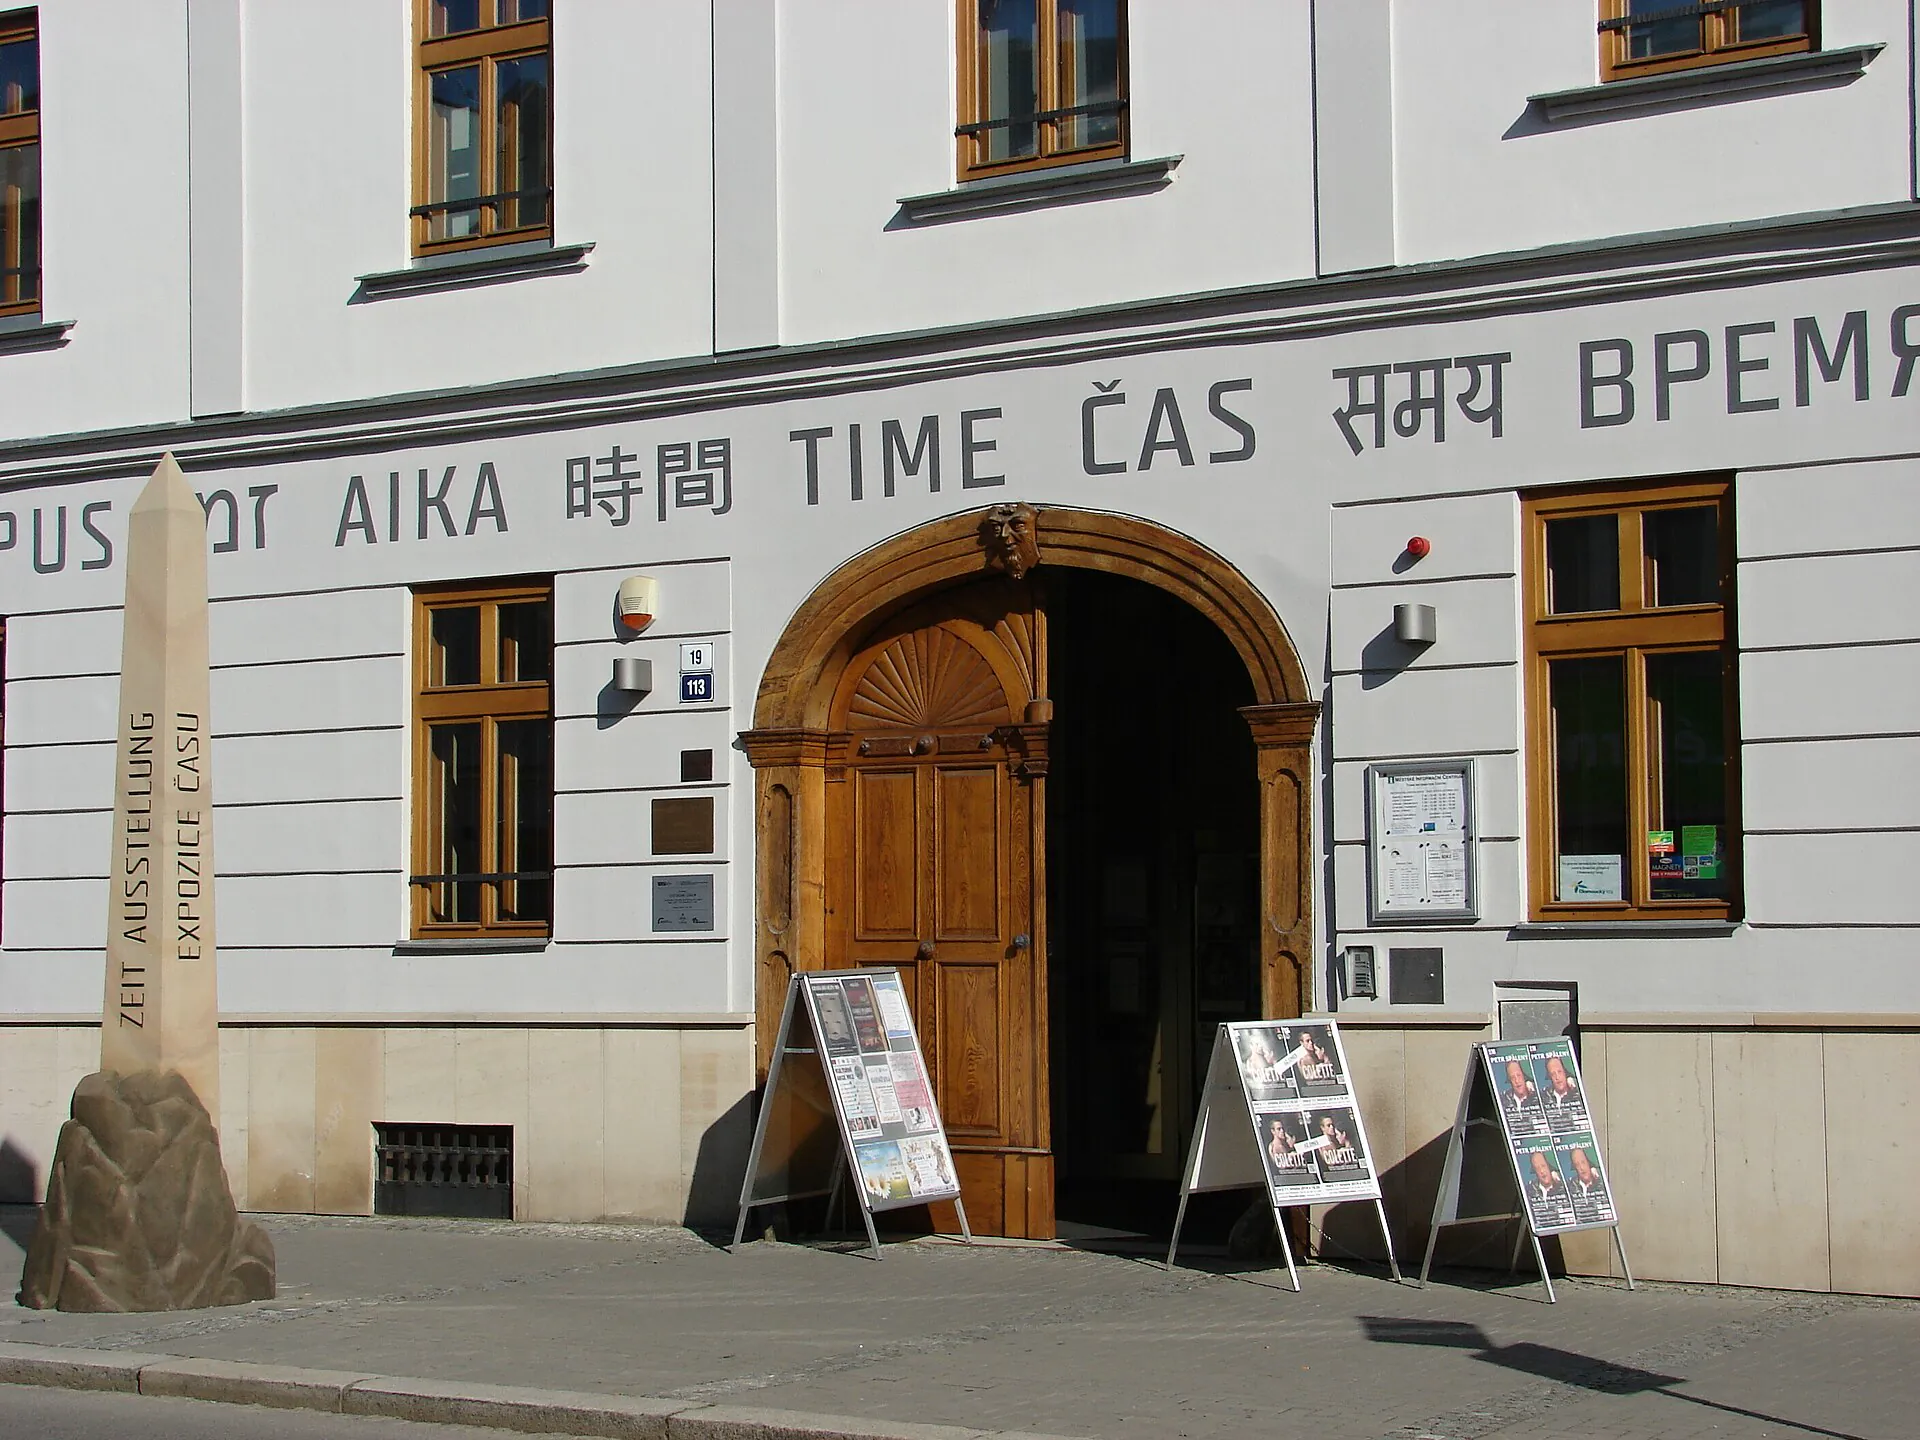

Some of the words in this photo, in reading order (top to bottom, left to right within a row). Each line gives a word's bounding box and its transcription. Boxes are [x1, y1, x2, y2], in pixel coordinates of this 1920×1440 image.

[1332, 351, 1512, 457] समय
[1579, 303, 1920, 430] ВРЕМЯ
[789, 407, 1006, 506] TIME
[1081, 377, 1257, 476] ČAS
[335, 462, 509, 547] AIKA
[565, 437, 732, 528] 時間
[687, 678, 705, 696] 113
[689, 649, 702, 665] 19
[173, 712, 200, 793] ČASU
[123, 712, 155, 944] AUSSTELLUNG
[177, 809, 201, 960] EXPOZICE
[120, 961, 146, 1029] ZEIT
[1302, 1063, 1335, 1080] COLETTE
[1274, 1152, 1307, 1169] COLETTE
[1323, 1148, 1358, 1165] COLETTE
